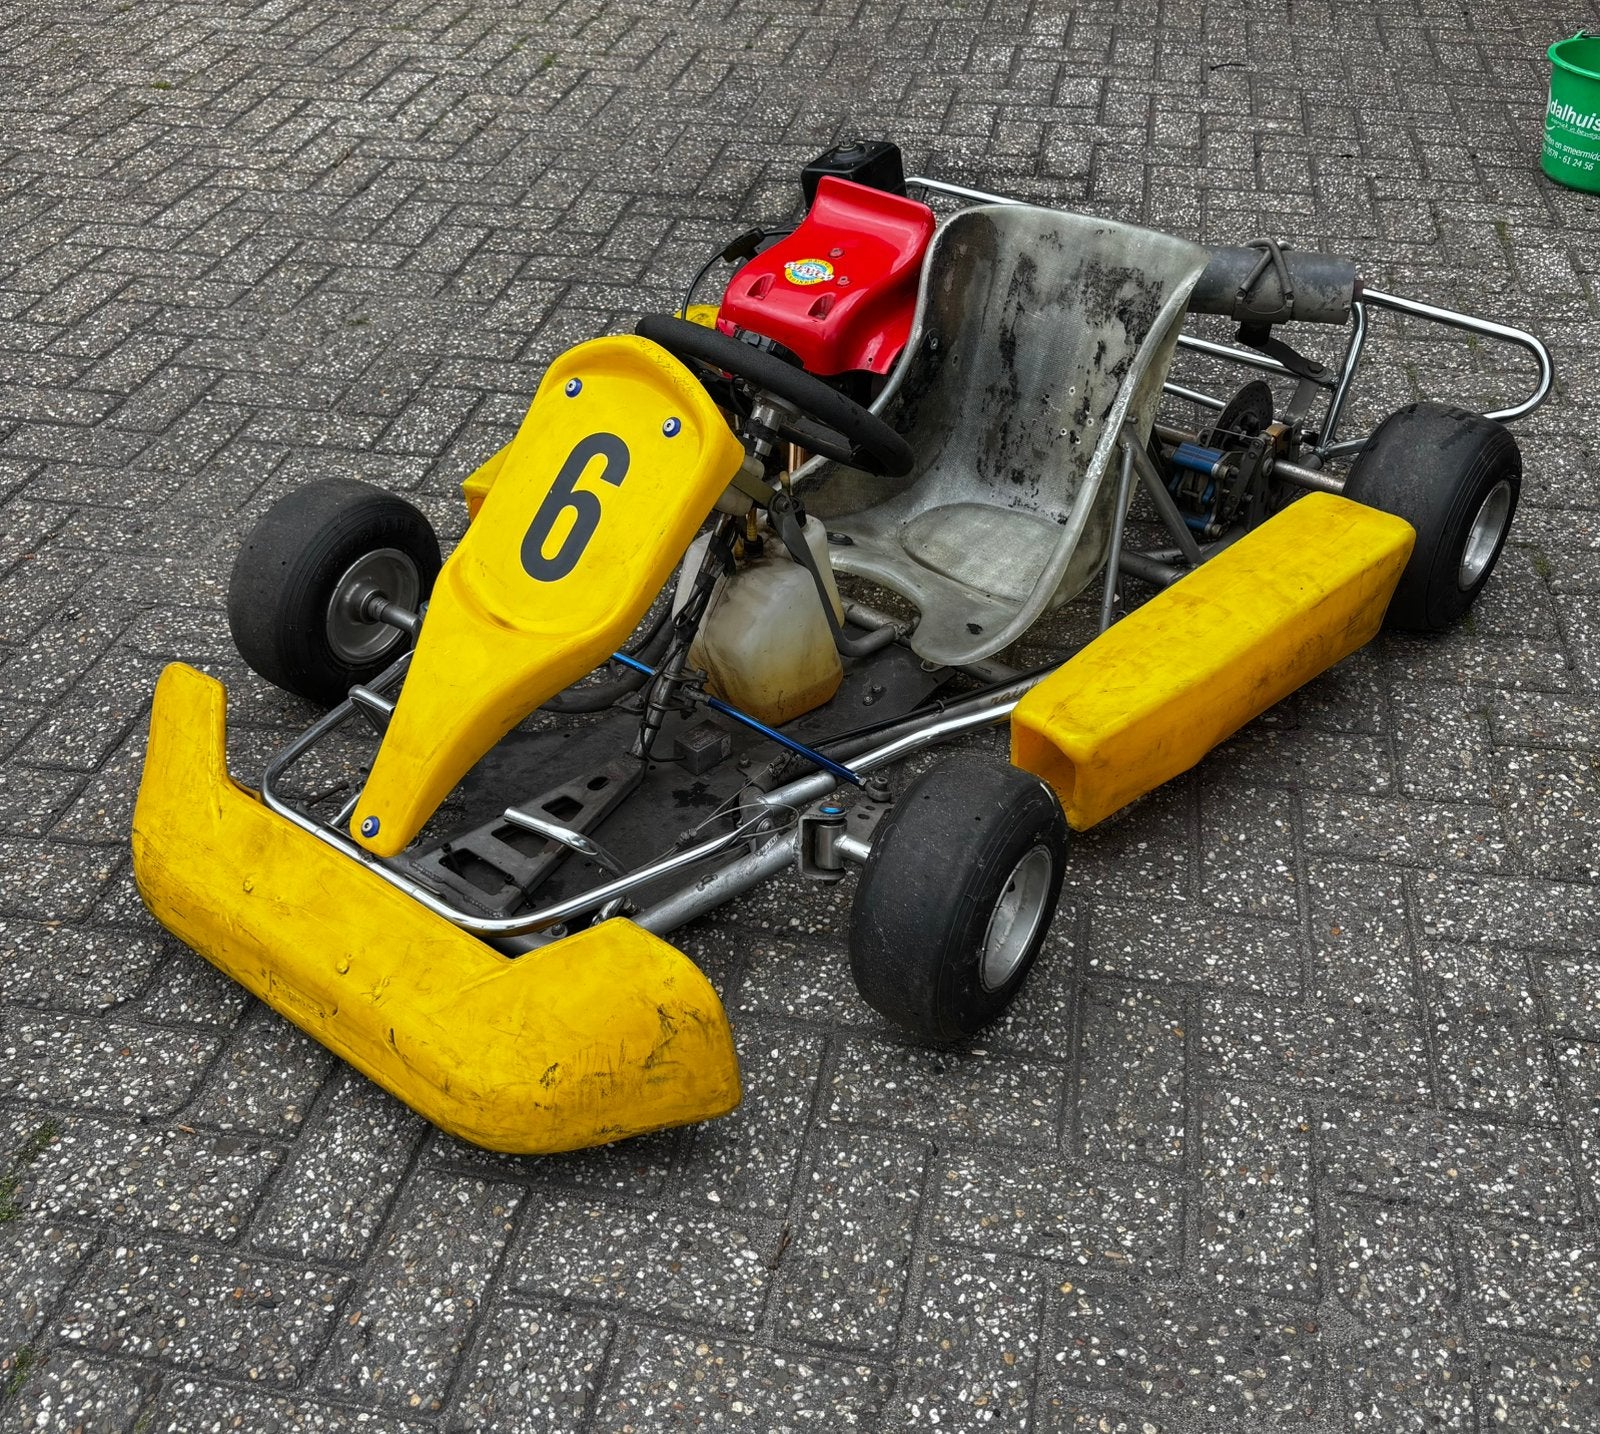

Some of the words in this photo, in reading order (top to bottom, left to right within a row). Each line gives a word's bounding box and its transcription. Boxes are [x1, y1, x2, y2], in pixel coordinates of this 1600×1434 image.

[1562, 155, 1571, 165] 61
[1572, 158, 1583, 168] 24
[1583, 161, 1595, 171] 56
[520, 432, 630, 582] 6
